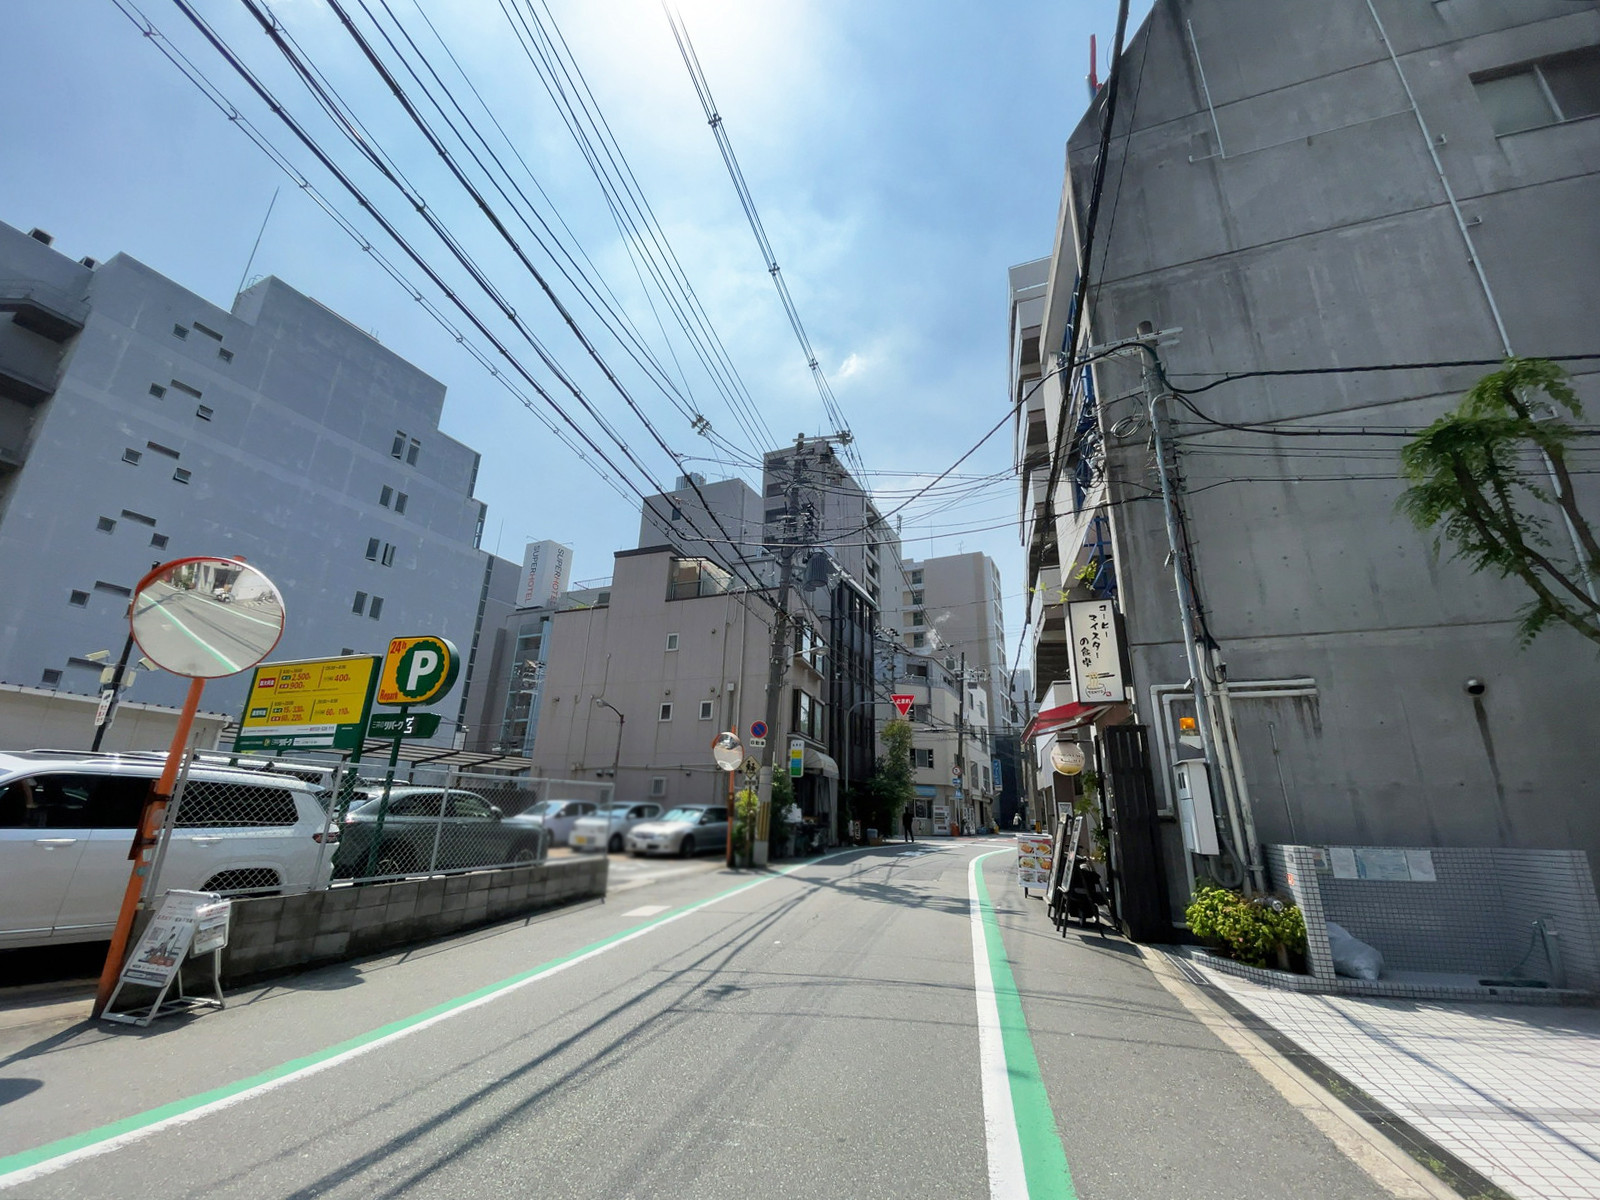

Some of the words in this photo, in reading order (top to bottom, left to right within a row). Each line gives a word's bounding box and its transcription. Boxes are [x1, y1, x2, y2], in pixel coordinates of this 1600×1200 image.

[524, 545, 541, 604] SUPERHOTEL
[1088, 613, 1102, 659] マイスター
[1098, 604, 1110, 638] コーヒー
[390, 640, 407, 654] 24h
[1079, 636, 1092, 668] の食卓
[406, 649, 439, 691] P
